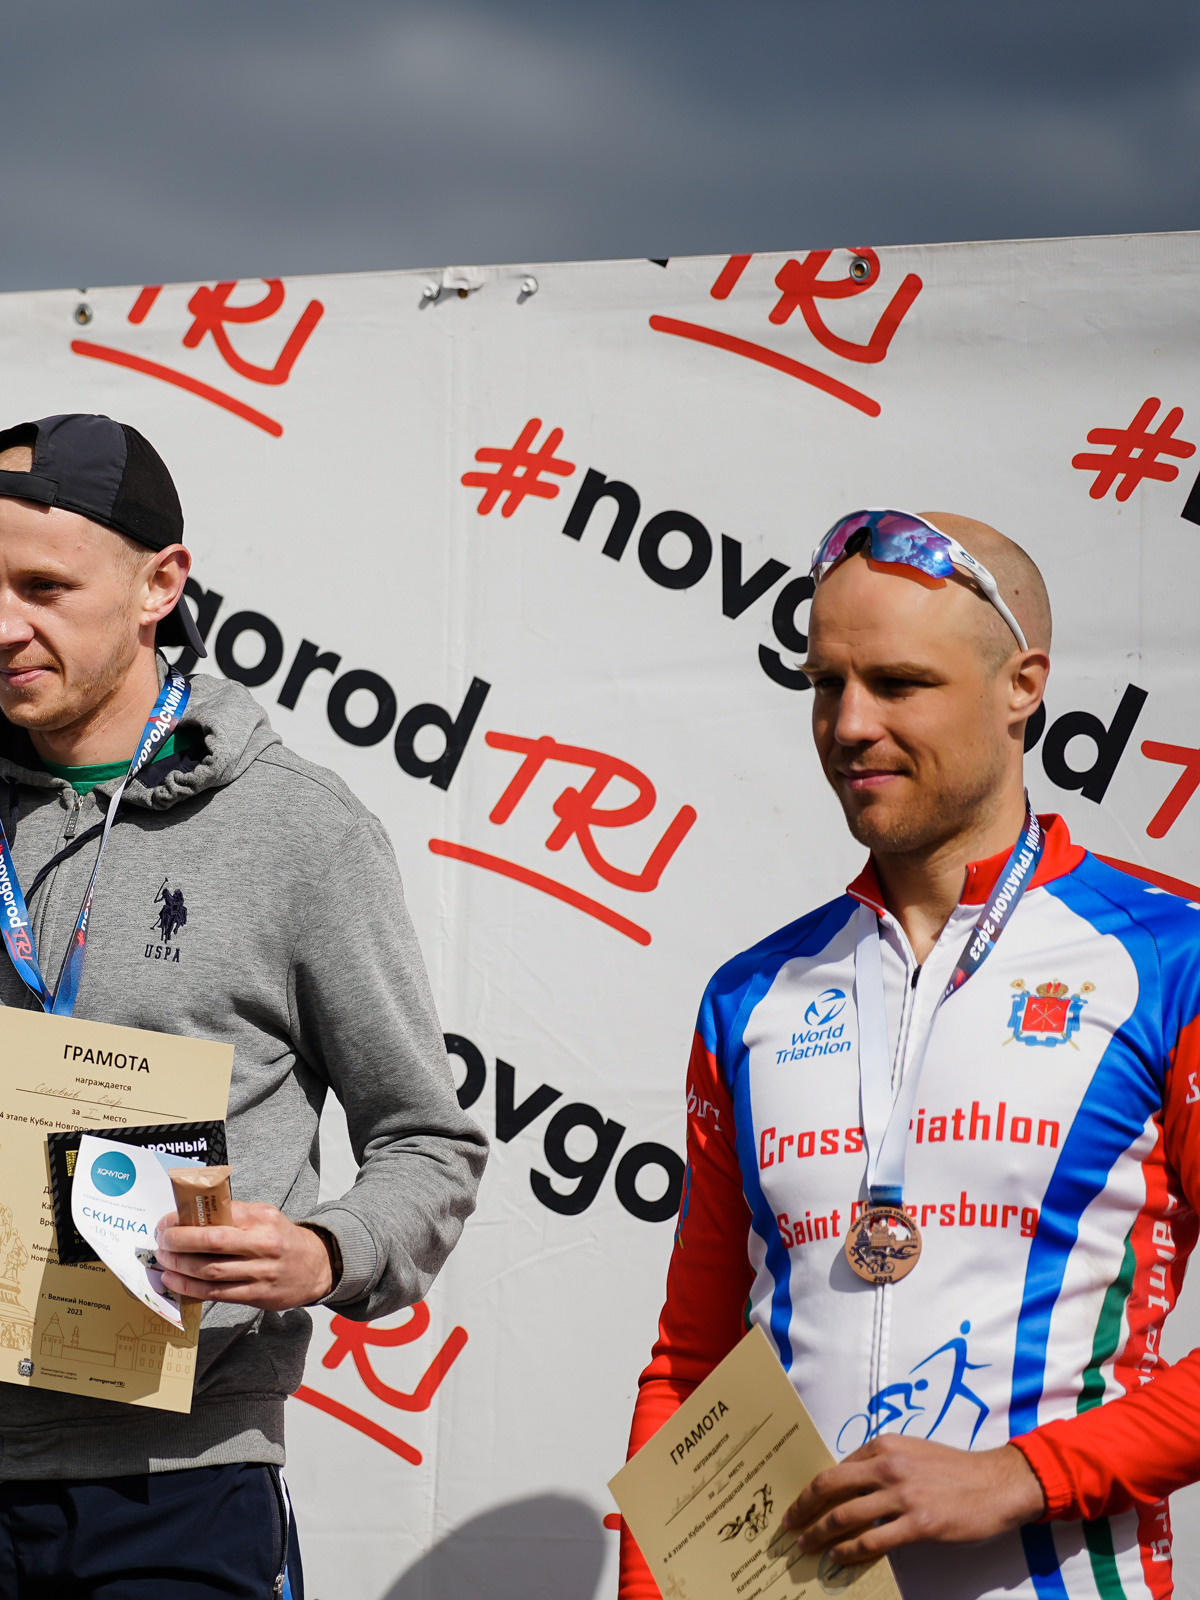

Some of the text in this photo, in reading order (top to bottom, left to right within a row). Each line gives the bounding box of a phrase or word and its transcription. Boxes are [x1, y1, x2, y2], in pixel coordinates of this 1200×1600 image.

[989, 851, 1034, 925] ТРИАТЛОН
[145, 944, 180, 962] USPA
[969, 923, 995, 962] 2023
[792, 1023, 845, 1046] World
[63, 1044, 150, 1073] ГРАМОТА
[776, 1041, 851, 1065] Triathlon
[75, 1077, 132, 1092] награждается
[0, 1111, 4, 1119] 4
[6, 1113, 28, 1124] этапе
[30, 1116, 54, 1128] Кубка
[103, 1114, 127, 1123] место
[760, 1101, 1060, 1169] Cross iathlon
[82, 1206, 148, 1235] СКИДКА
[196, 1195, 206, 1227] ШОКОЛА
[777, 1210, 840, 1249] Saint
[79, 1263, 106, 1273] области
[48, 1293, 77, 1304] Великий
[79, 1299, 111, 1311] Новгород
[67, 1308, 83, 1316] 2023
[669, 1400, 729, 1465] ГРАМОТА
[693, 1433, 730, 1473] награждается
[672, 1538, 690, 1556] этапе
[688, 1520, 706, 1538] Кубка
[706, 1481, 745, 1520] Новгородской
[744, 1459, 766, 1484] области
[764, 1452, 774, 1462] по
[772, 1422, 800, 1454] триатлону
[707, 1461, 745, 1500] за место
[730, 1549, 762, 1583] Дистанция
[736, 1564, 767, 1594] Категория
